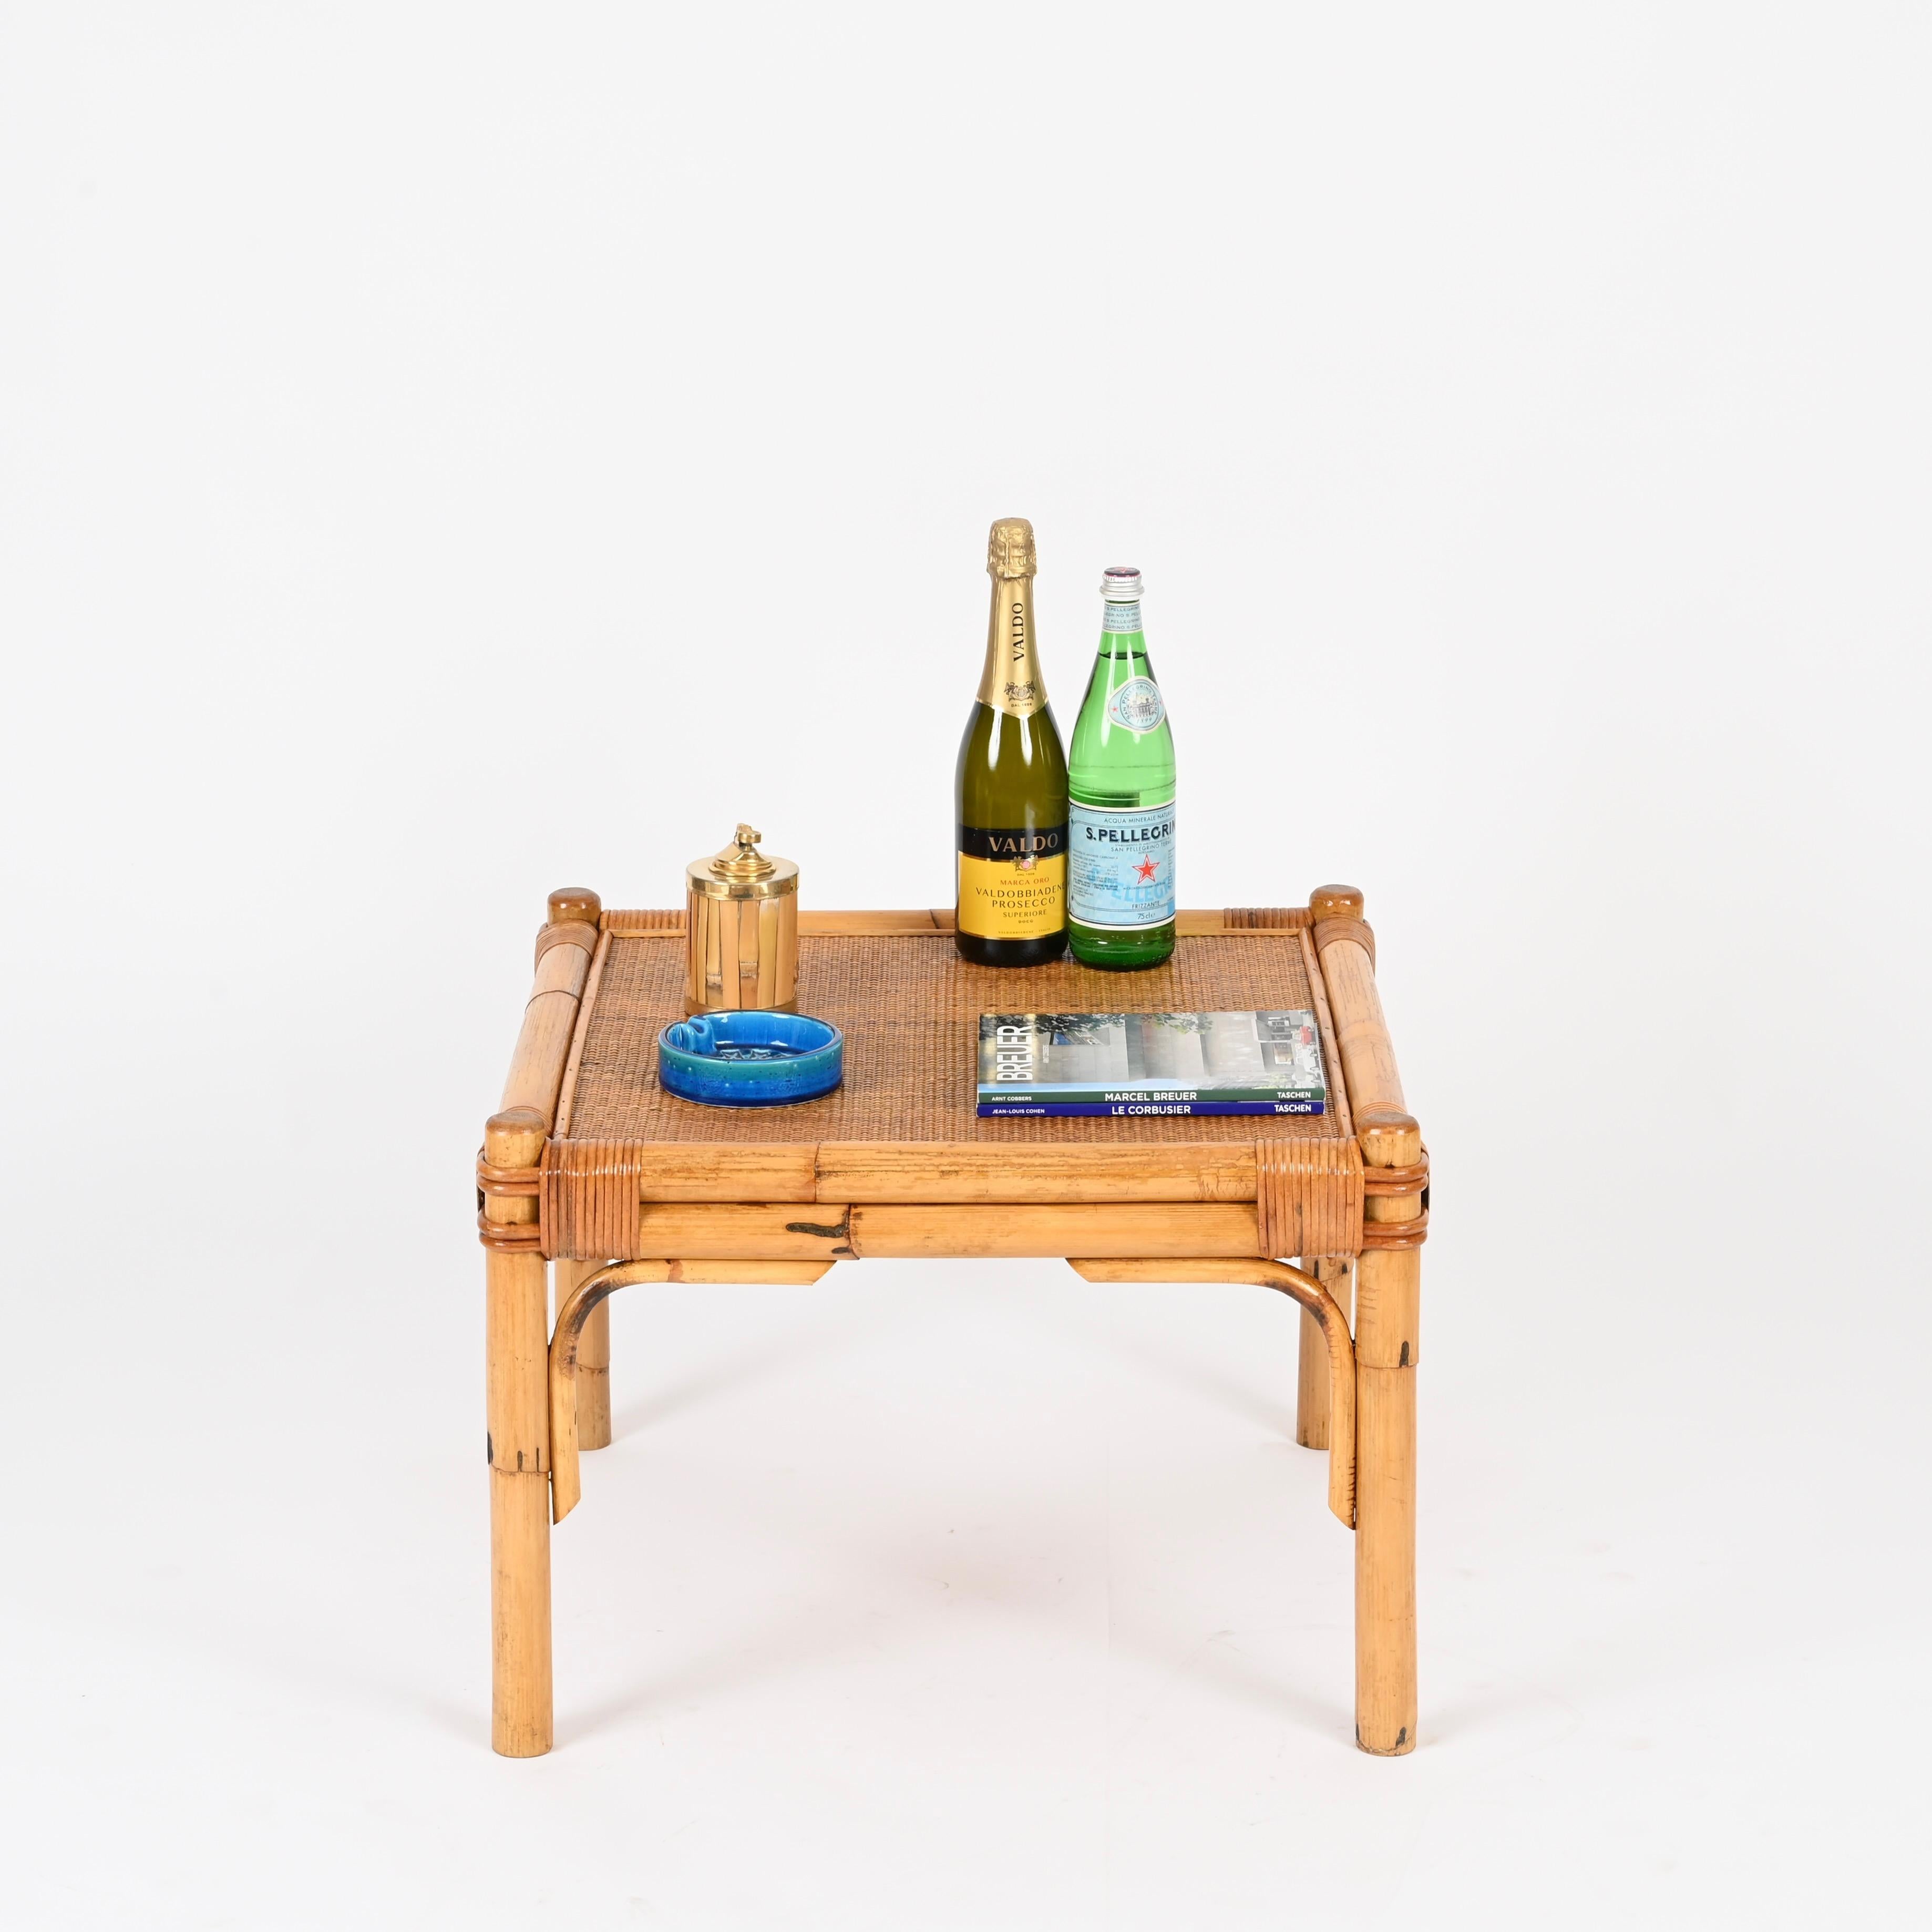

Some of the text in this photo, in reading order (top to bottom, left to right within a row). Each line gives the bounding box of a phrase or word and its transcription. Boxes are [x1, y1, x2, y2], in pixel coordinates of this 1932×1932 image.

[1012, 603, 1024, 662] VALDO
[1122, 707, 1131, 720] SAN
[988, 833, 1059, 852] VALDO
[1126, 843, 1159, 852] PELLEGRINO
[992, 896, 1055, 909] PROSECCO
[1132, 900, 1160, 909] FRIZZANTE
[1003, 909, 1047, 918] SUPERIORE
[996, 1025, 1033, 1081] BREUER
[1105, 1092, 1150, 1102] MARCEL
[1153, 1092, 1197, 1101] BREUER
[1112, 1106, 1125, 1115] LE
[1128, 1105, 1191, 1115] CORBUSIER
[1274, 1104, 1312, 1113] TASCHEN
